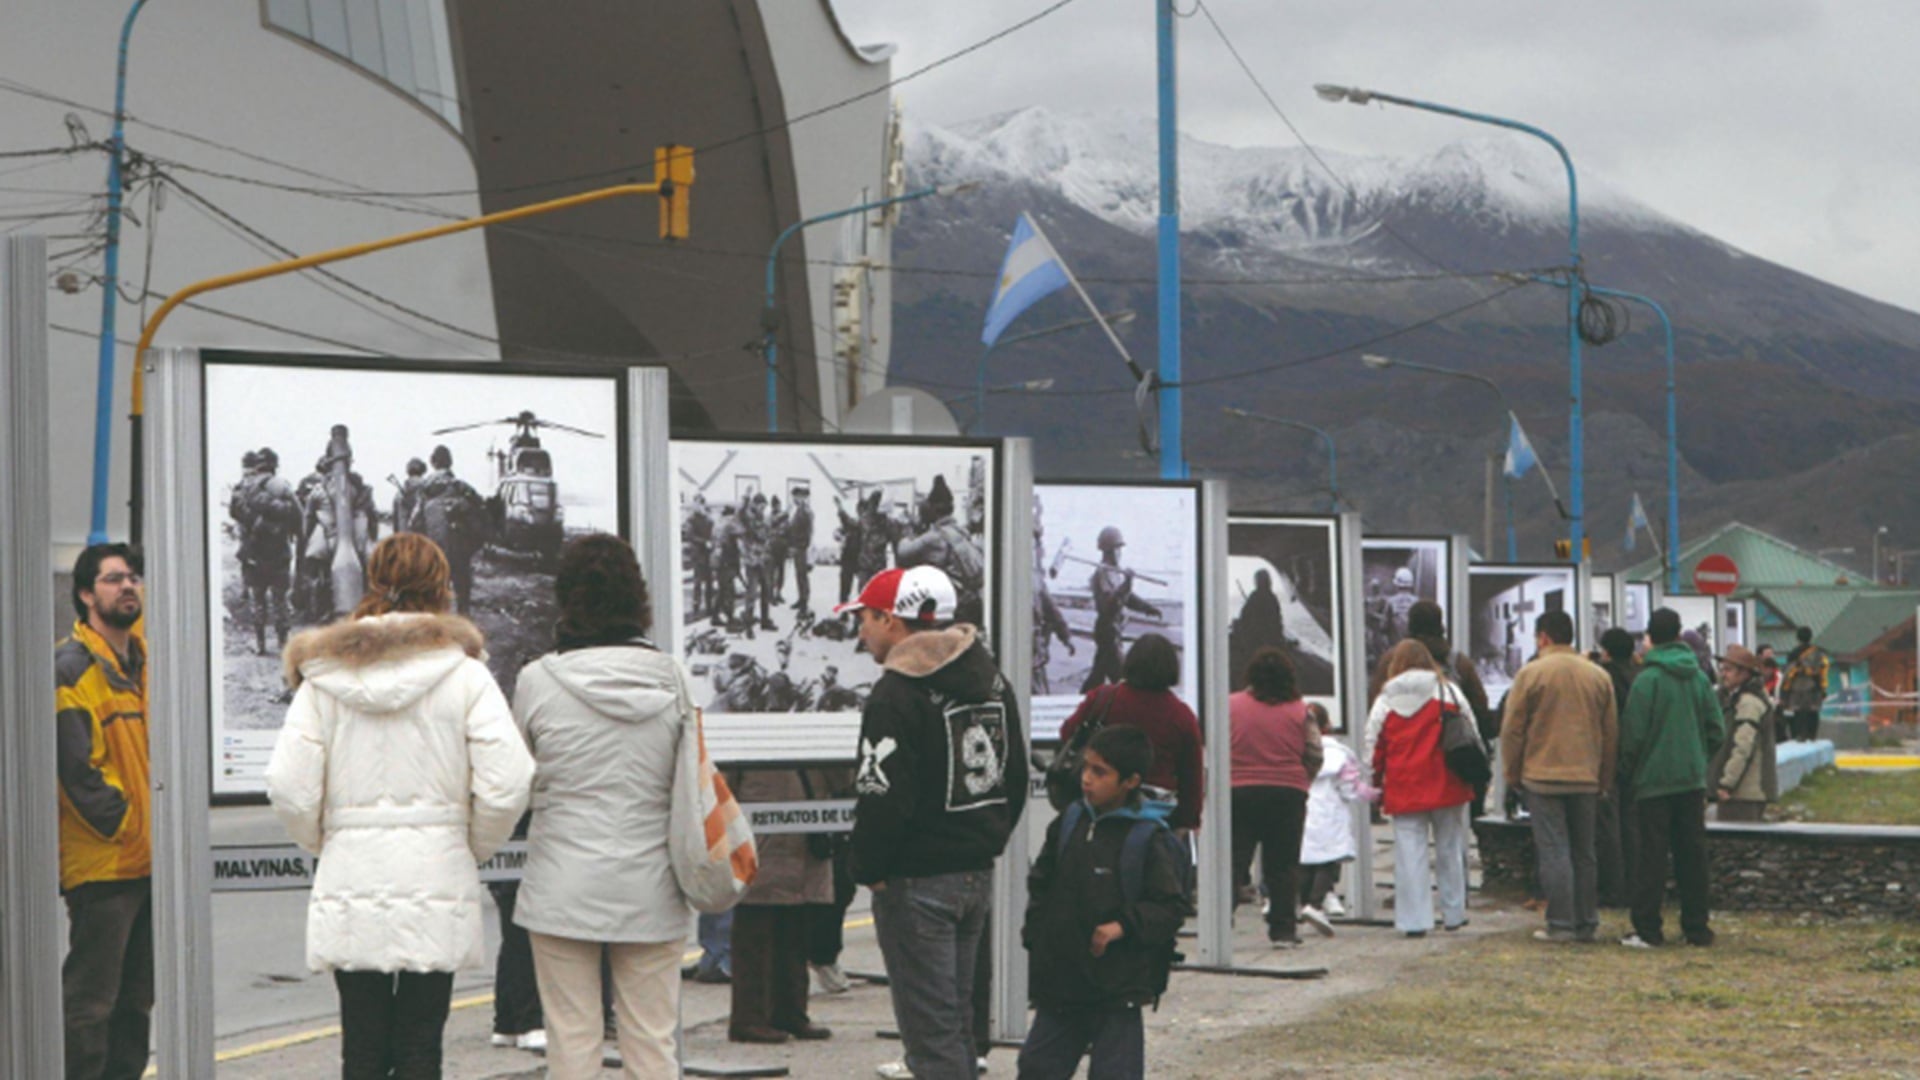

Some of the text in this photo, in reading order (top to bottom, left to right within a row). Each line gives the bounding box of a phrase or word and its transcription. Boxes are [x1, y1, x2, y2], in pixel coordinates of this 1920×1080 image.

[962, 723, 998, 796] 9
[752, 809, 818, 826] RETRATOS
[822, 808, 838, 823] DE
[214, 857, 309, 879] MALVINAS,
